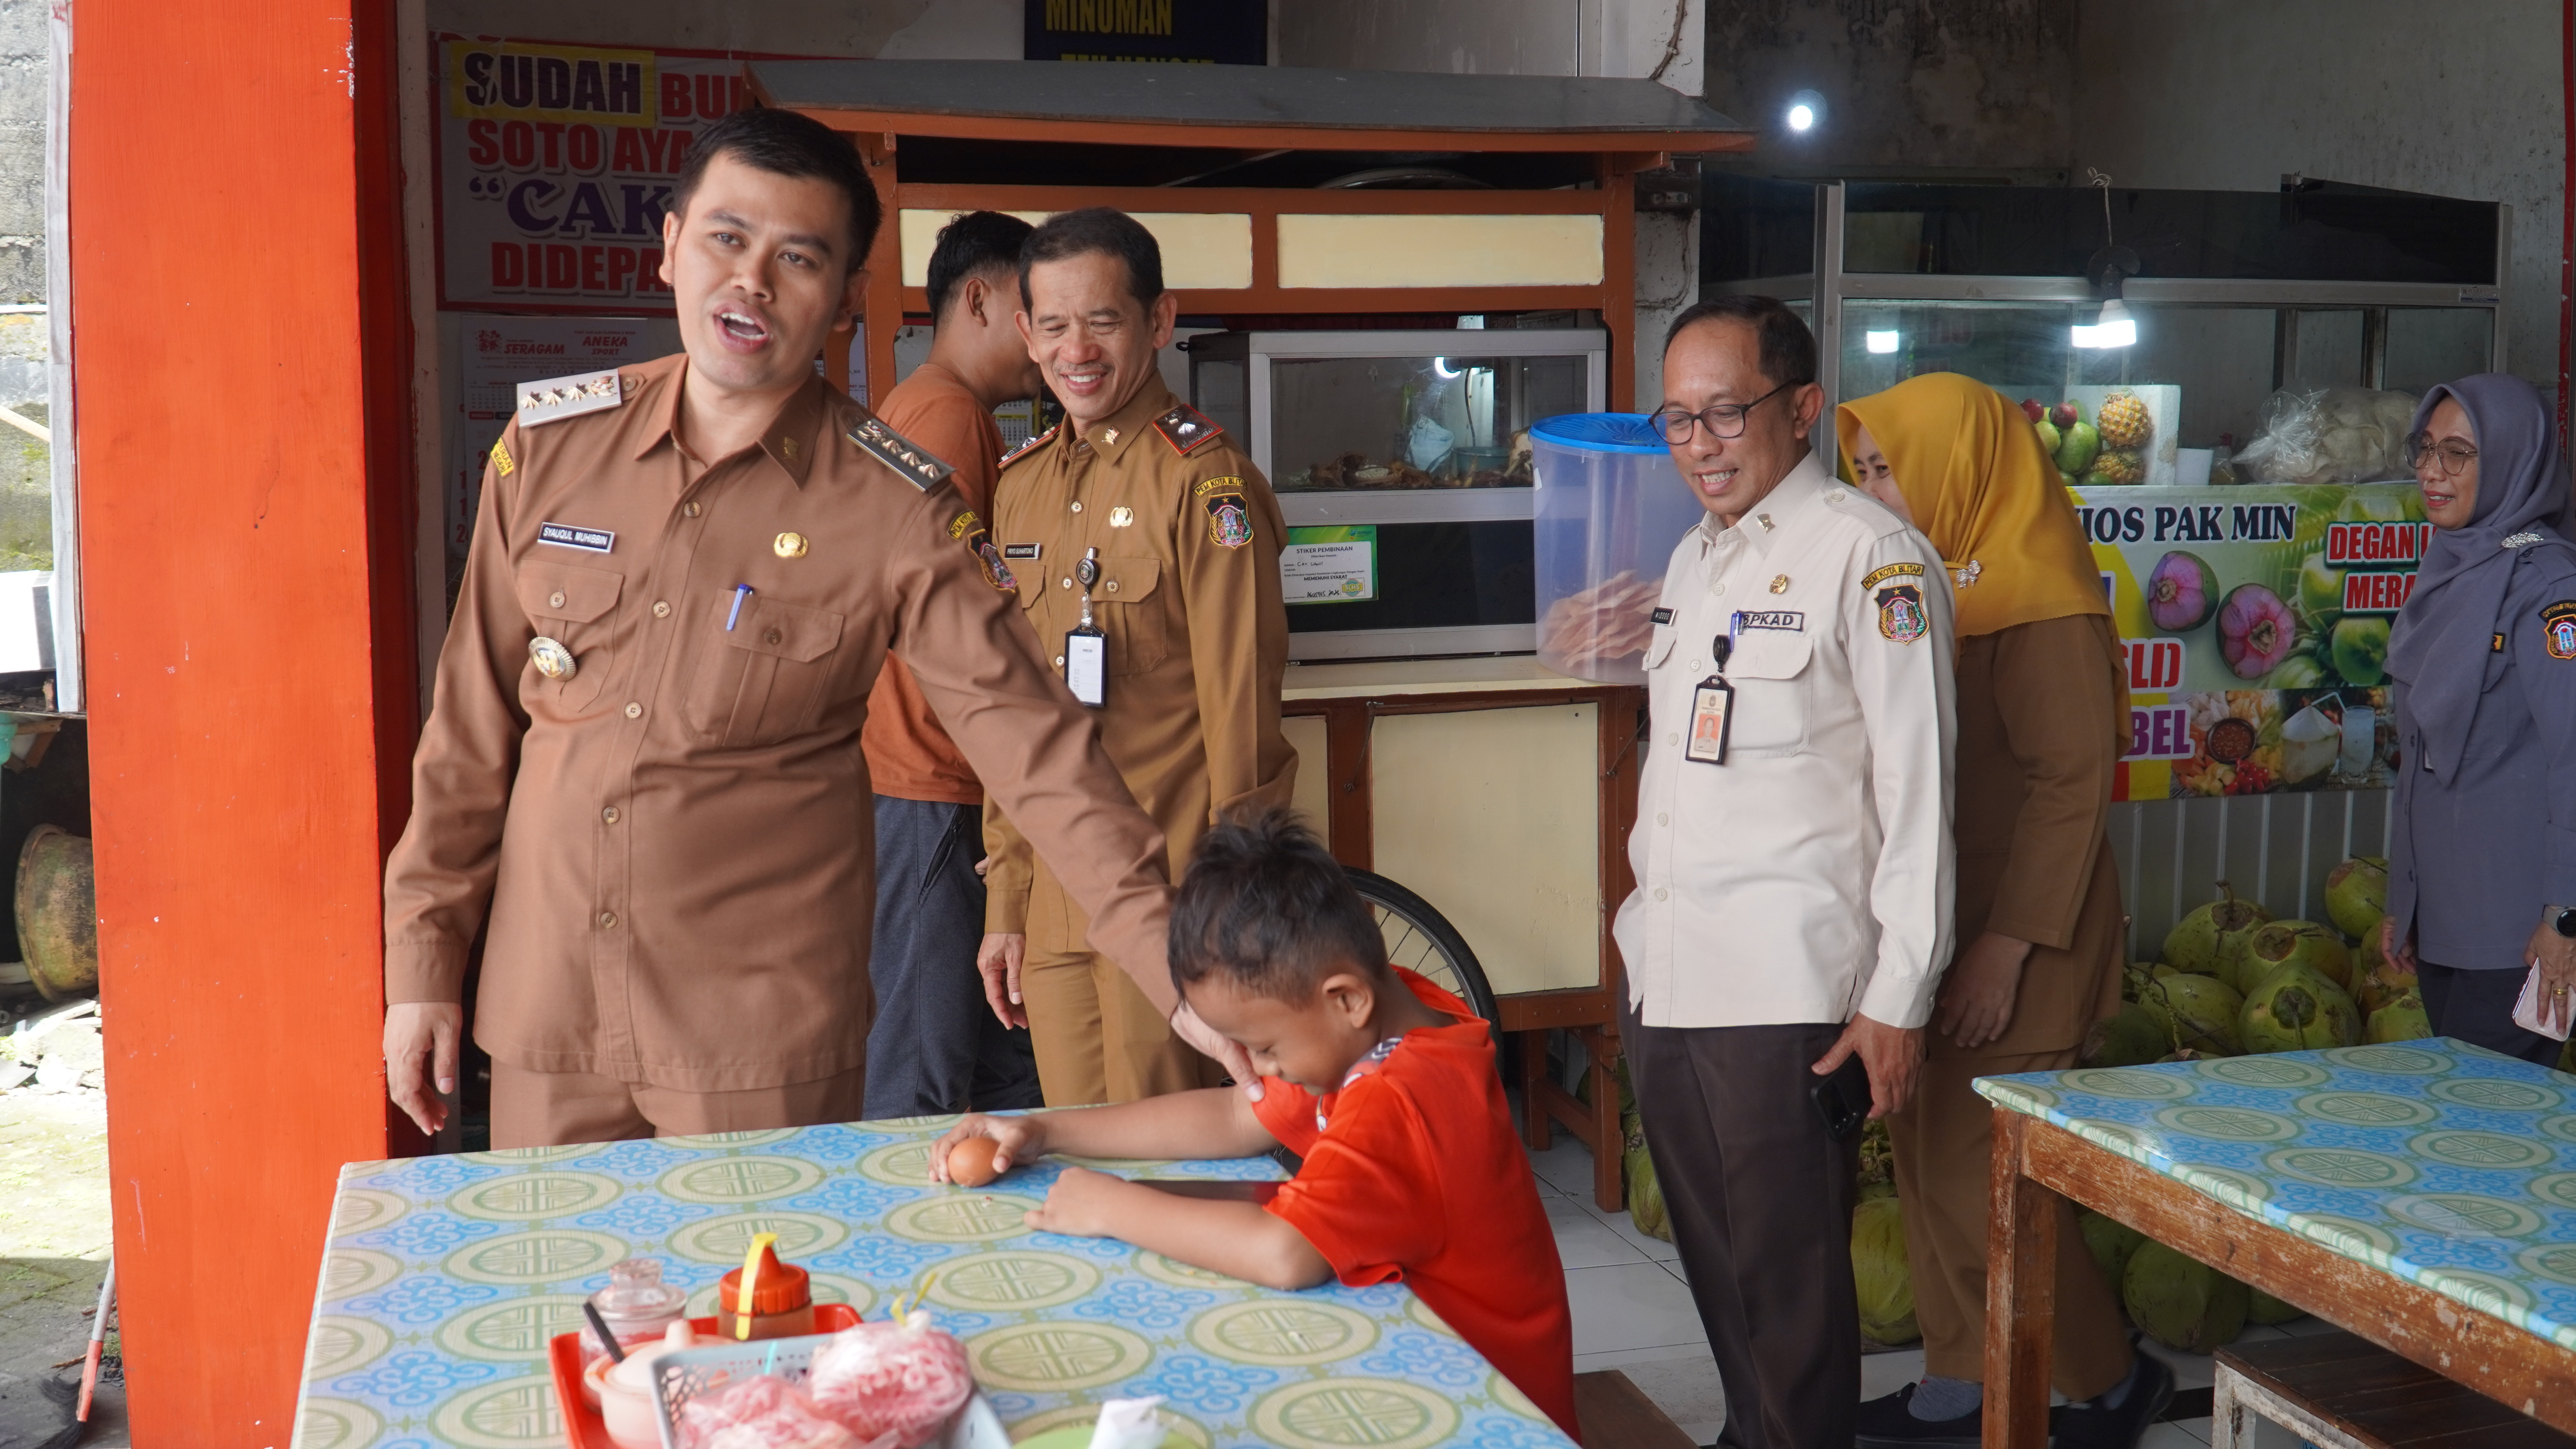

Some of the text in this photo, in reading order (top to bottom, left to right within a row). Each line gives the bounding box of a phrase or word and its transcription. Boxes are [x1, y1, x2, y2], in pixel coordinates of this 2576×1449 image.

[1046, 0, 1172, 35] MINUMAN
[464, 51, 641, 115] SUDAH
[467, 118, 600, 170] SOTO
[504, 344, 565, 354] SERAGAM
[582, 336, 628, 347] ANEKA
[1196, 484, 1209, 494] PEM
[1210, 478, 1227, 488] KOTA
[543, 527, 608, 545] SYAUQUL MUHIBBIN
[2075, 505, 2296, 543] IOS PAK MIN
[2329, 525, 2414, 560] DEGAN
[1865, 564, 1921, 587] PEM KOTA BLITAR
